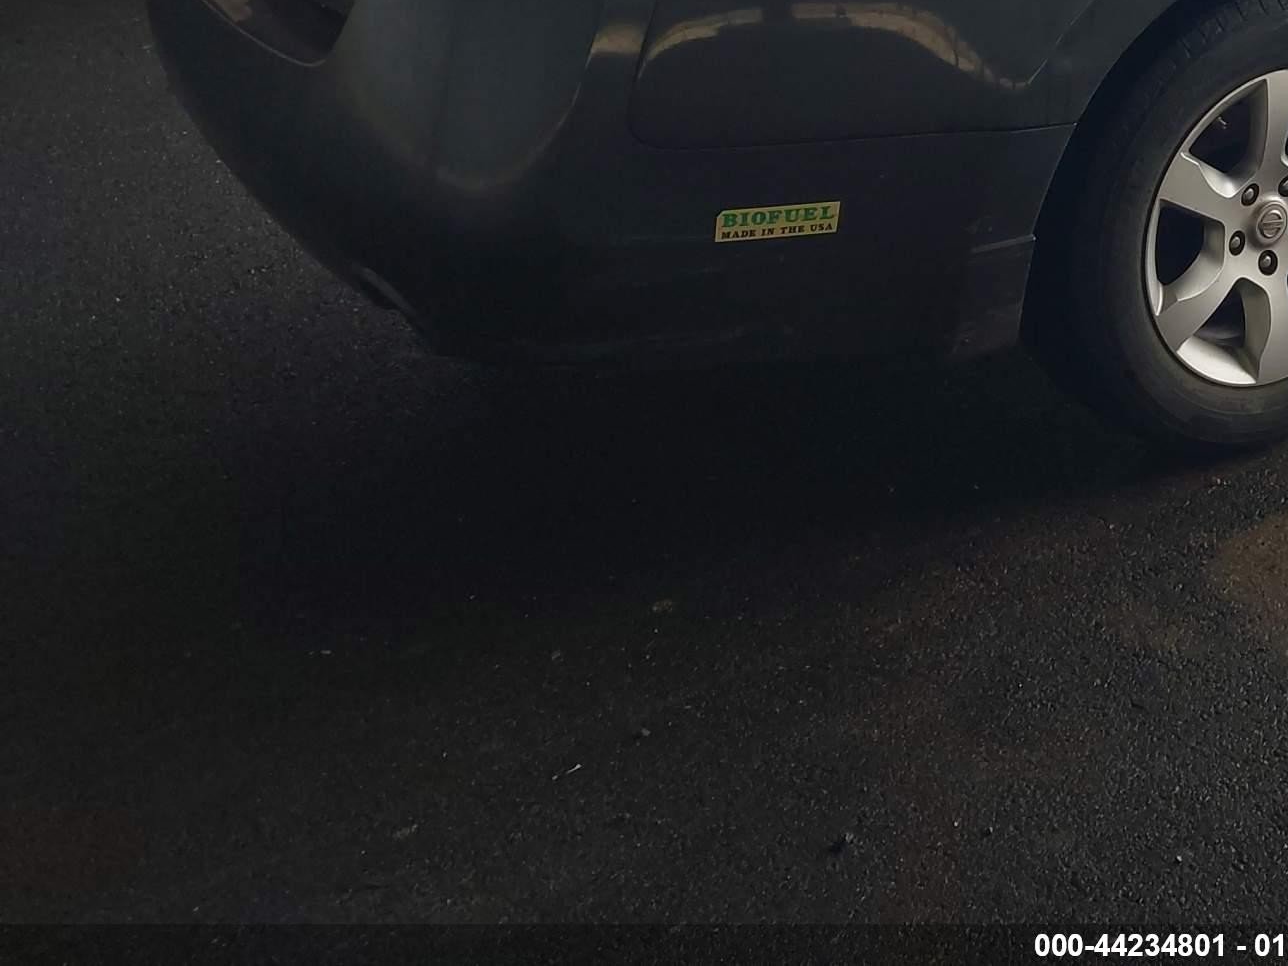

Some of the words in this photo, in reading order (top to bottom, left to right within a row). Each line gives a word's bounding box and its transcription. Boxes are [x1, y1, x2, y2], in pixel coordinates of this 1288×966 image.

[721, 205, 835, 228] BIOFUEL
[721, 229, 756, 240] MADE
[761, 228, 775, 237] IN
[781, 225, 805, 234] THE
[810, 222, 834, 233] USA
